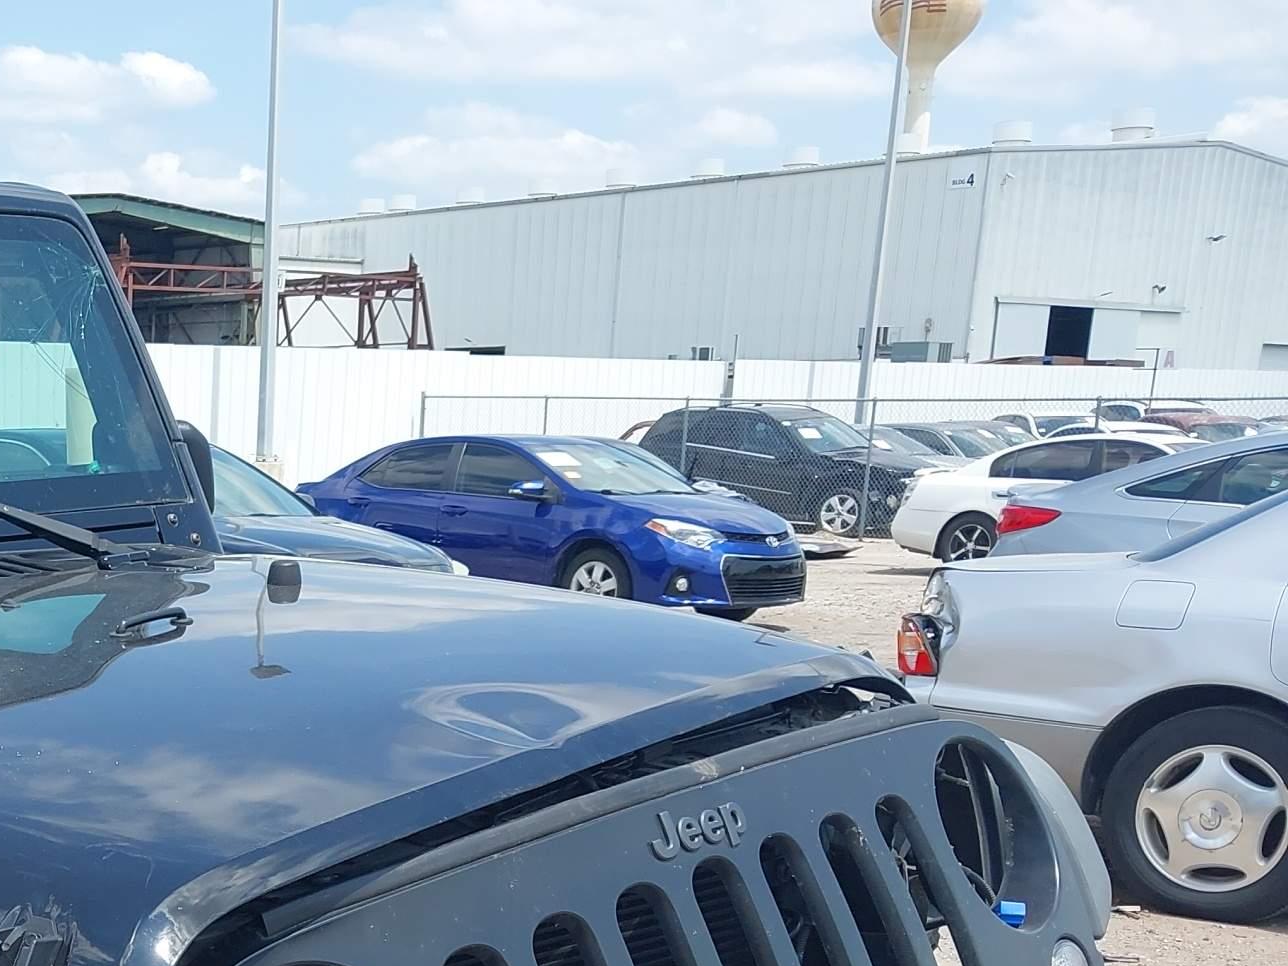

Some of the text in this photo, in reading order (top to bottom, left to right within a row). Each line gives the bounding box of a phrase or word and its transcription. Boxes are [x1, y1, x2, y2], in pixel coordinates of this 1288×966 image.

[966, 173, 974, 186] 4
[1163, 350, 1174, 368] A
[649, 802, 746, 861] Jeep
